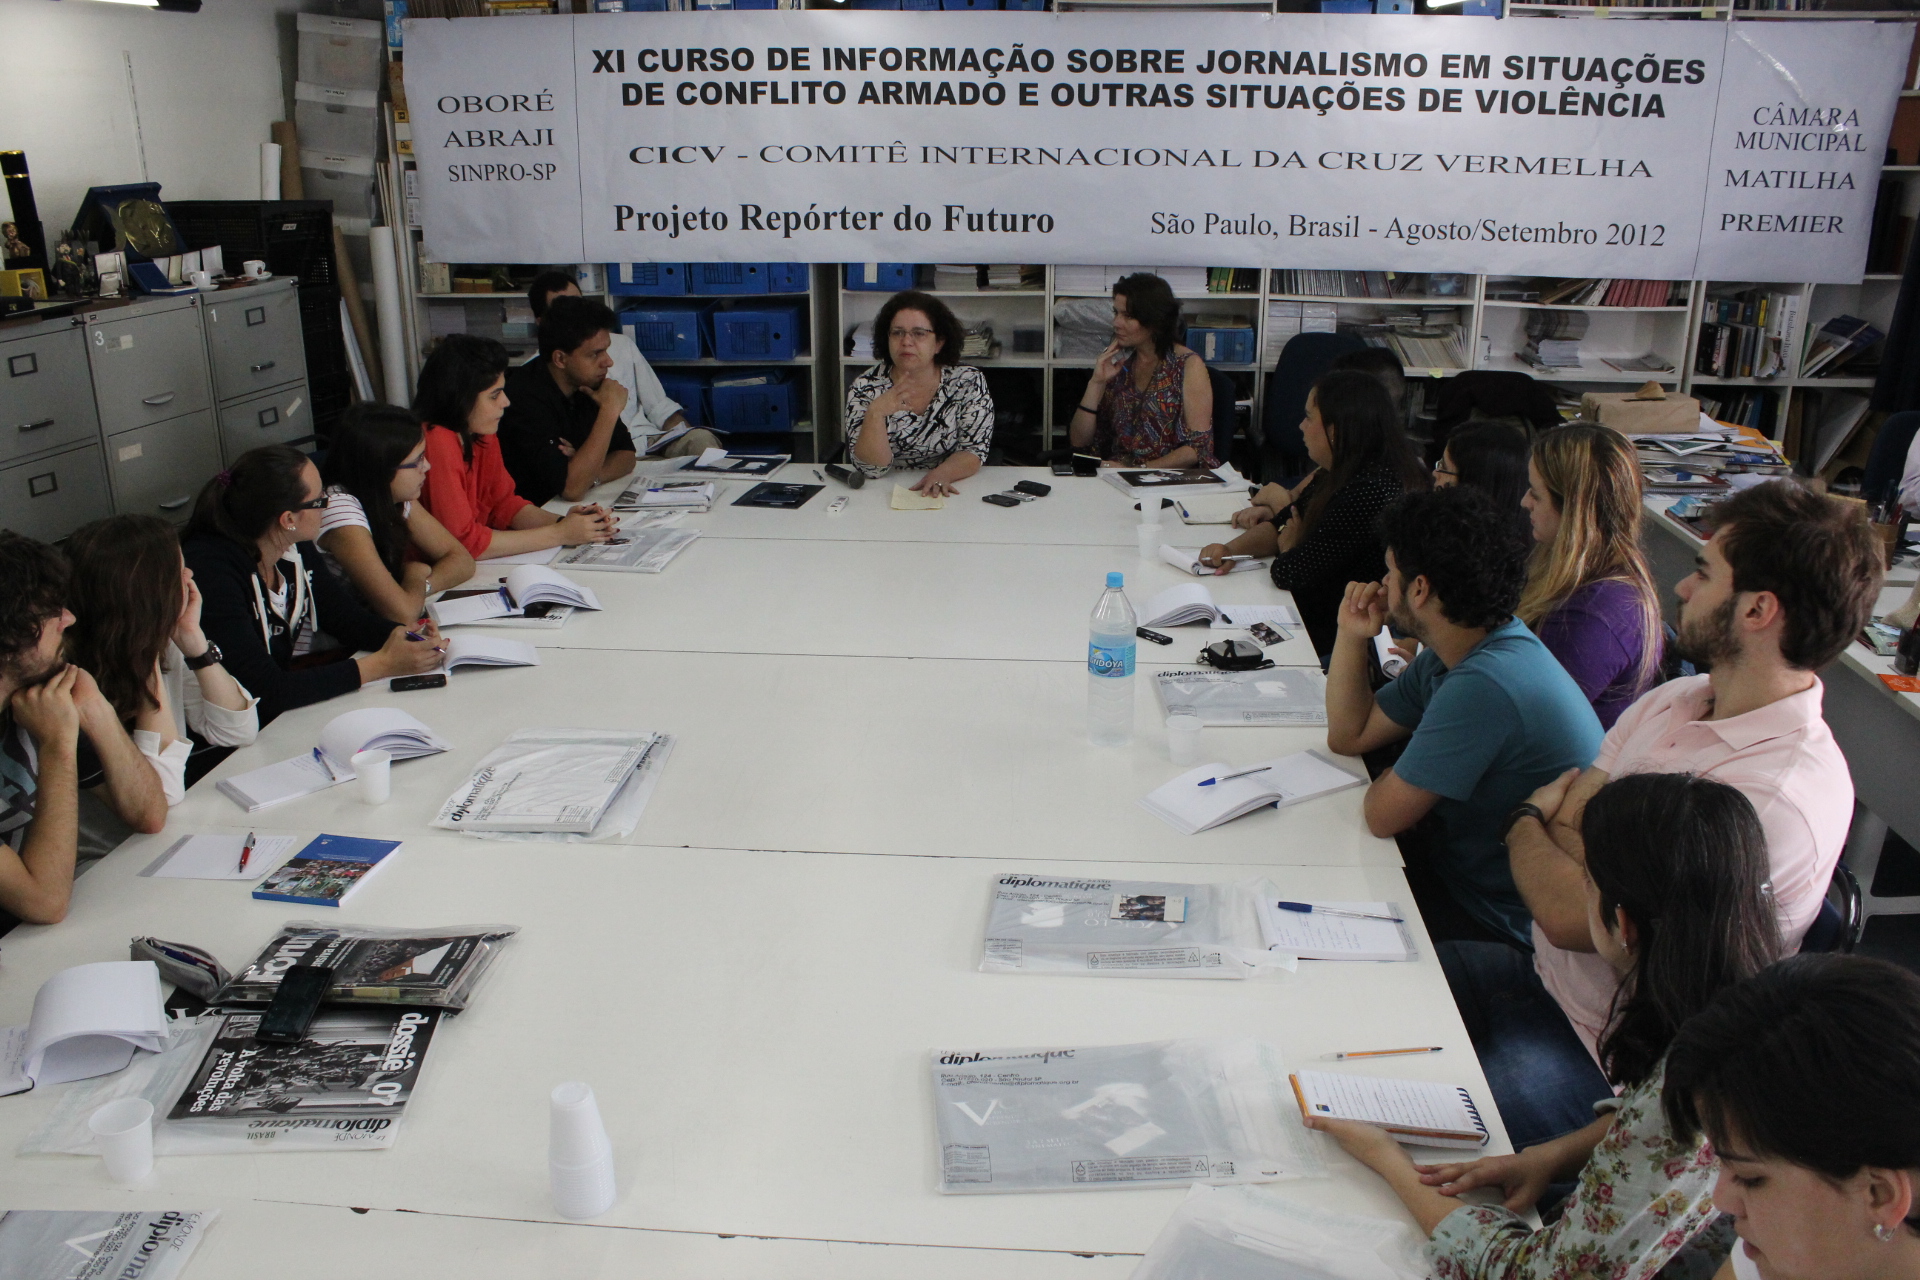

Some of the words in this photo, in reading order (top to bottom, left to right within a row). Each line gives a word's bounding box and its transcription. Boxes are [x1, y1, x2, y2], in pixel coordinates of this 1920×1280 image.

[592, 50, 625, 73] XI
[638, 48, 754, 72] CURSO
[768, 47, 810, 71] DE
[823, 43, 1054, 78] INFORMAÇÃO
[1067, 49, 1184, 73] SOBRE
[1196, 50, 1427, 77] JORNALISMO
[1441, 54, 1490, 79] EM
[1503, 53, 1705, 89] SITUAÇÕES
[438, 89, 554, 113] OBORÉ
[622, 82, 664, 106] DE
[676, 81, 846, 105] CONFLITO
[858, 81, 1006, 106] ARMADO
[1019, 83, 1038, 106] E
[1051, 83, 1194, 107] OUTRAS
[1206, 81, 1405, 116] SITUAÇÕES
[1418, 88, 1462, 112] DE
[1475, 90, 1665, 118] VIOLÊNCIA
[1754, 102, 1859, 126] CÂMARA
[444, 129, 554, 147] ABRAJI
[1736, 132, 1866, 152] MUNICIPAL
[629, 146, 725, 164] CICV
[760, 141, 908, 163] COMITÊ
[922, 146, 1242, 167] INTERNACIONAL
[1254, 150, 1307, 168] DA
[1318, 152, 1423, 171] CRUZ
[1436, 155, 1652, 177] VERMELHA
[449, 163, 556, 182] SINPRO-SP
[1725, 170, 1855, 189] MATILHA
[614, 204, 728, 238] Projeto
[739, 203, 883, 238] Repórter
[894, 205, 931, 231] do
[943, 205, 1054, 233] Futuro
[1151, 212, 1194, 234] São
[1204, 213, 1278, 239] Paulo,
[1289, 215, 1359, 237] Brasil
[1384, 217, 1597, 245] Agosto/Setembro
[1606, 223, 1665, 246] 2012
[1721, 214, 1843, 233] PREMIER
[210, 308, 218, 323] 1
[94, 331, 105, 346] 3
[999, 876, 1112, 891] diplomatique
[241, 1049, 258, 1058] A
[382, 1012, 429, 1073] dossiê
[190, 1051, 235, 1113] revoluções
[222, 1059, 252, 1096] volta
[208, 1096, 234, 1112] das
[368, 1082, 402, 1106] 07
[246, 1131, 276, 1140] BRASIL
[169, 1217, 198, 1252] MONDE
